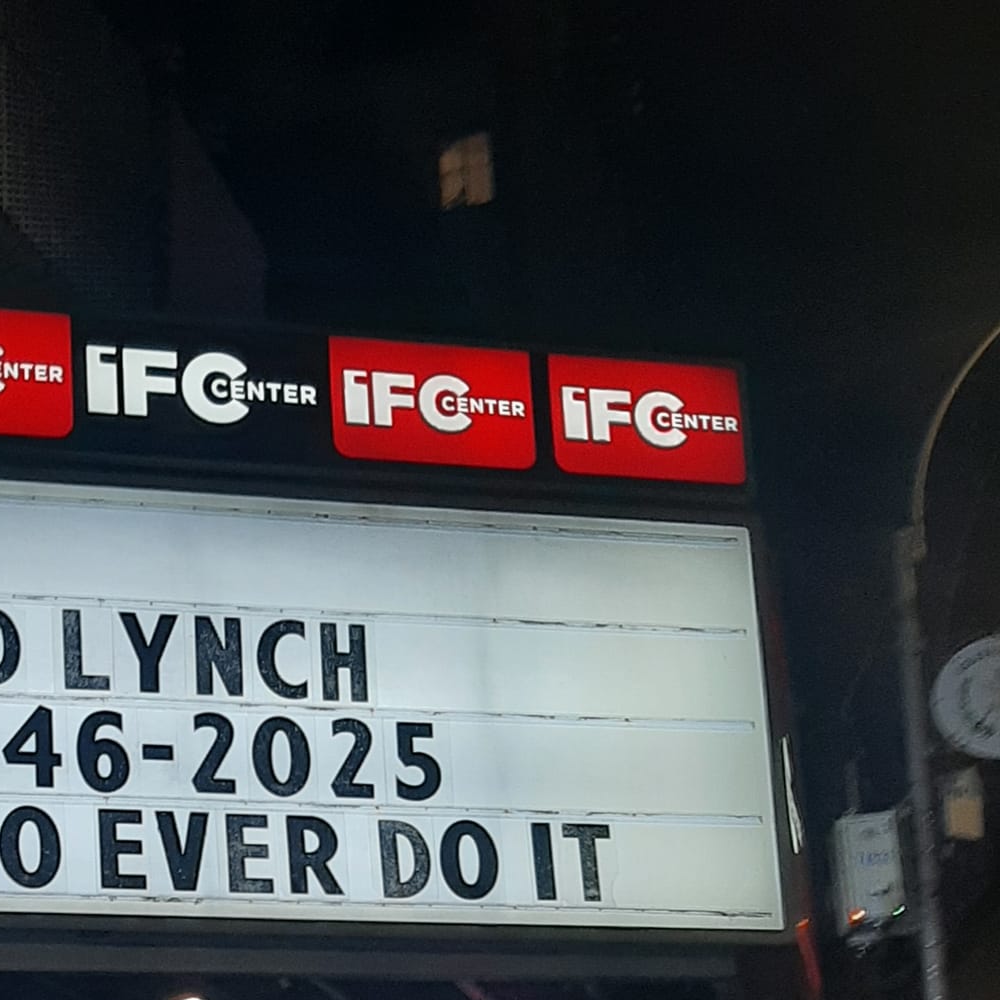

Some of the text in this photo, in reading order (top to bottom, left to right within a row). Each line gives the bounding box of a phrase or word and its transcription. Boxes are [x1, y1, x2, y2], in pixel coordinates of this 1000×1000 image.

[210, 378, 317, 405] CENTER
[441, 394, 525, 418] CENTER
[656, 411, 739, 432] CENTER
[62, 608, 369, 704] LYNCH
[98, 808, 345, 896] EVER
[378, 819, 499, 900] DO
[531, 822, 611, 902] IT
